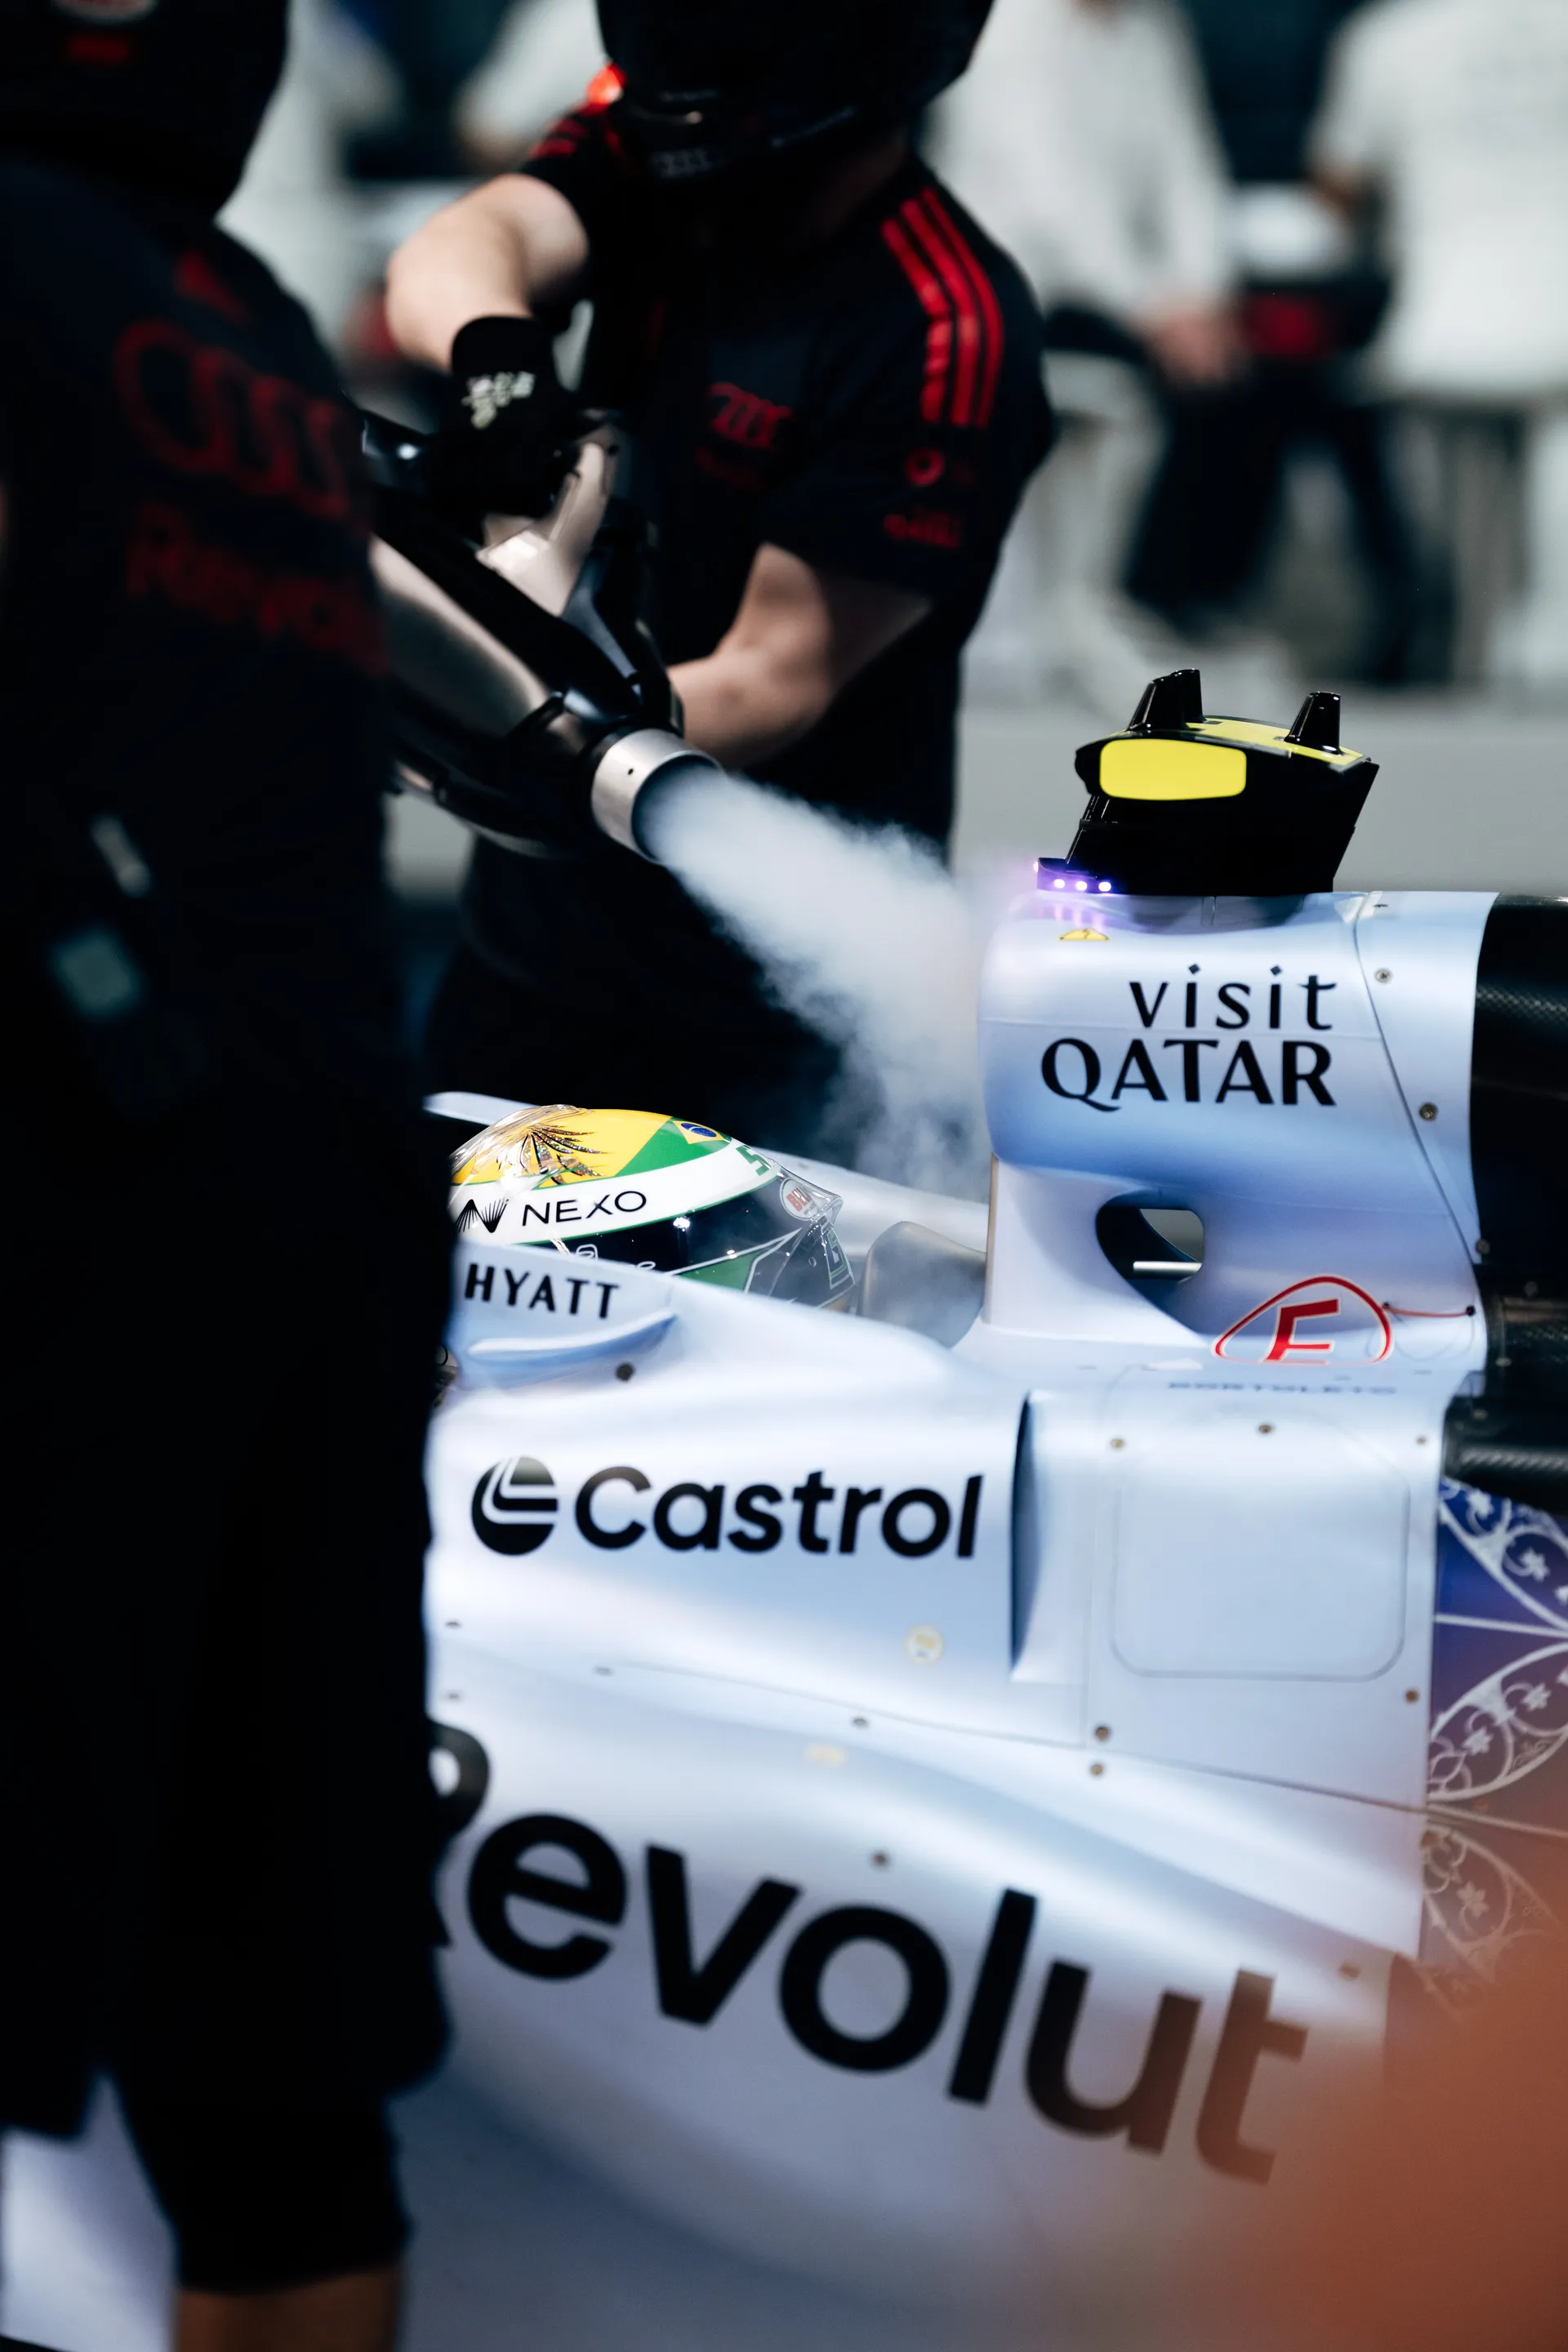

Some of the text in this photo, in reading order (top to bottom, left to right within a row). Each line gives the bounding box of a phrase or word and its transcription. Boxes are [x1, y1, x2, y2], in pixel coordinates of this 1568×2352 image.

[1129, 963, 1338, 1031] visit
[1040, 1037, 1339, 1113] QATAR
[522, 1190, 647, 1227] NEXO
[465, 1262, 621, 1320] HYATT
[574, 1465, 985, 1559] Castrol
